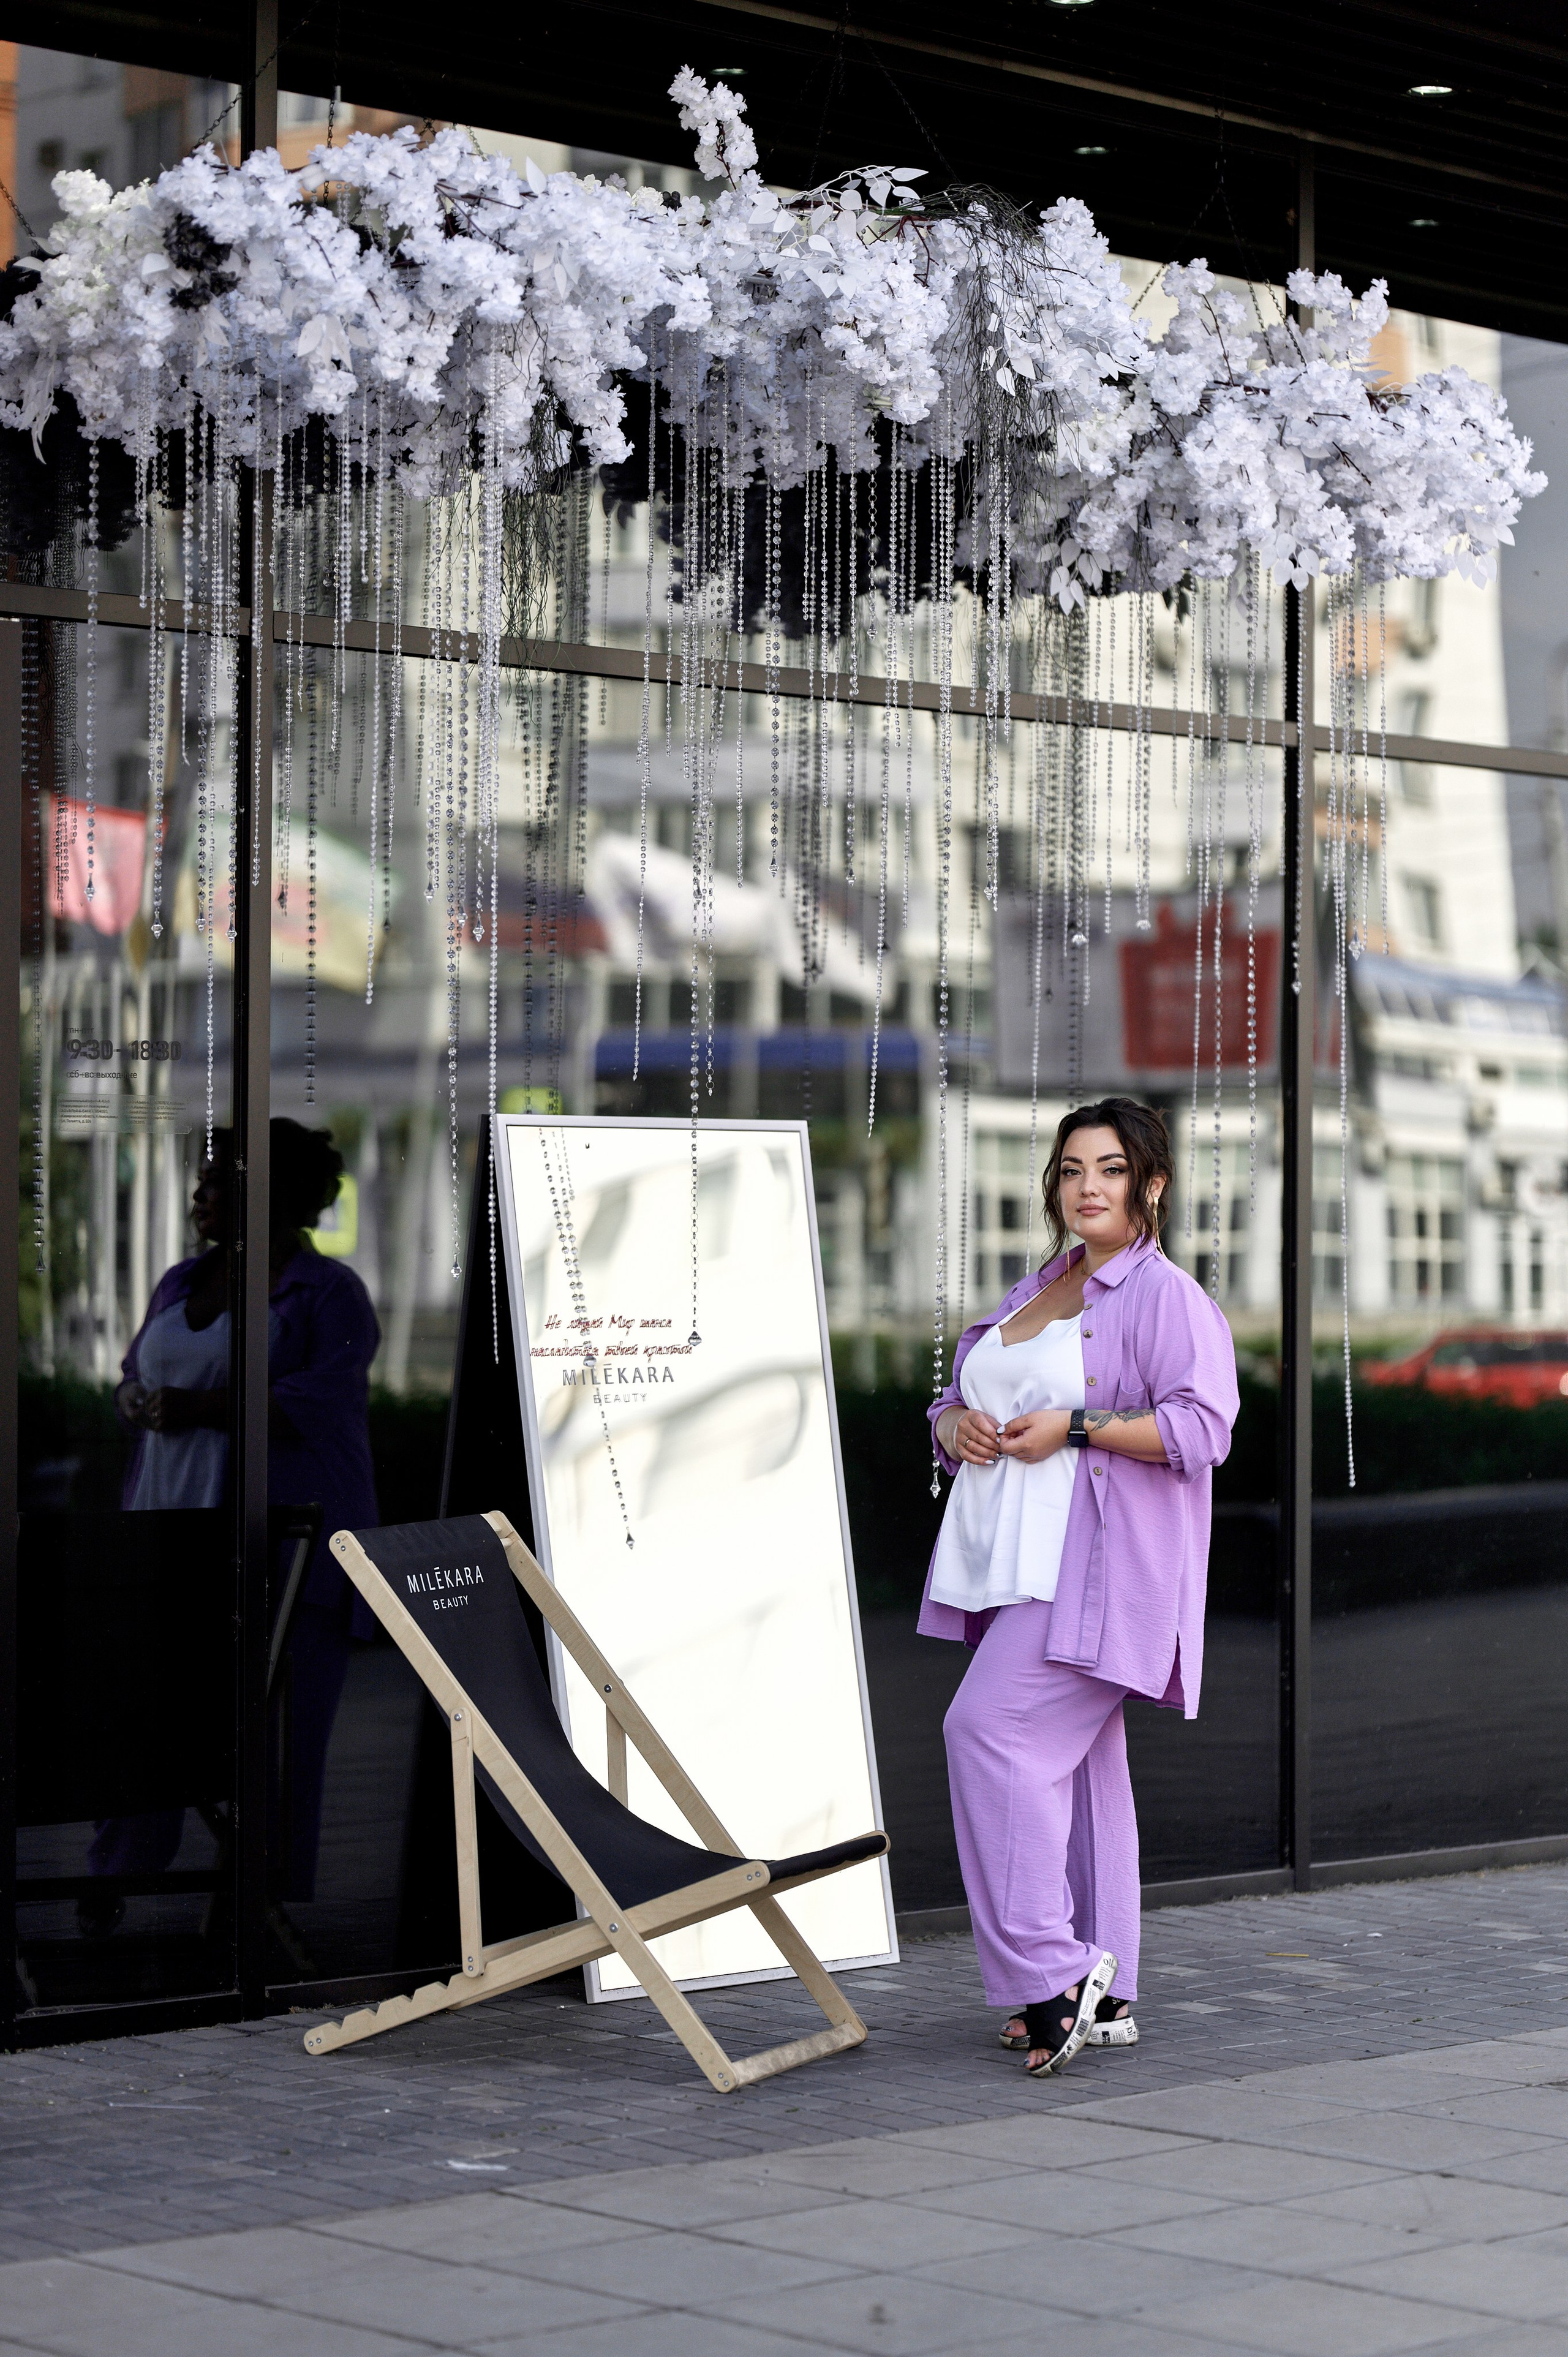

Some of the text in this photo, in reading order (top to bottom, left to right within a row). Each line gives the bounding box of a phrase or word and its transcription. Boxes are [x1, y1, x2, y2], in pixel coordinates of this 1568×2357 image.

[545, 1314, 562, 1330] Не
[608, 1314, 635, 1337] Мир
[563, 1363, 674, 1386] MILĒKARA
[593, 1392, 647, 1404] BEAUTY
[407, 1566, 484, 1593] MILĒKARA
[432, 1595, 469, 1610] BEAUTY
